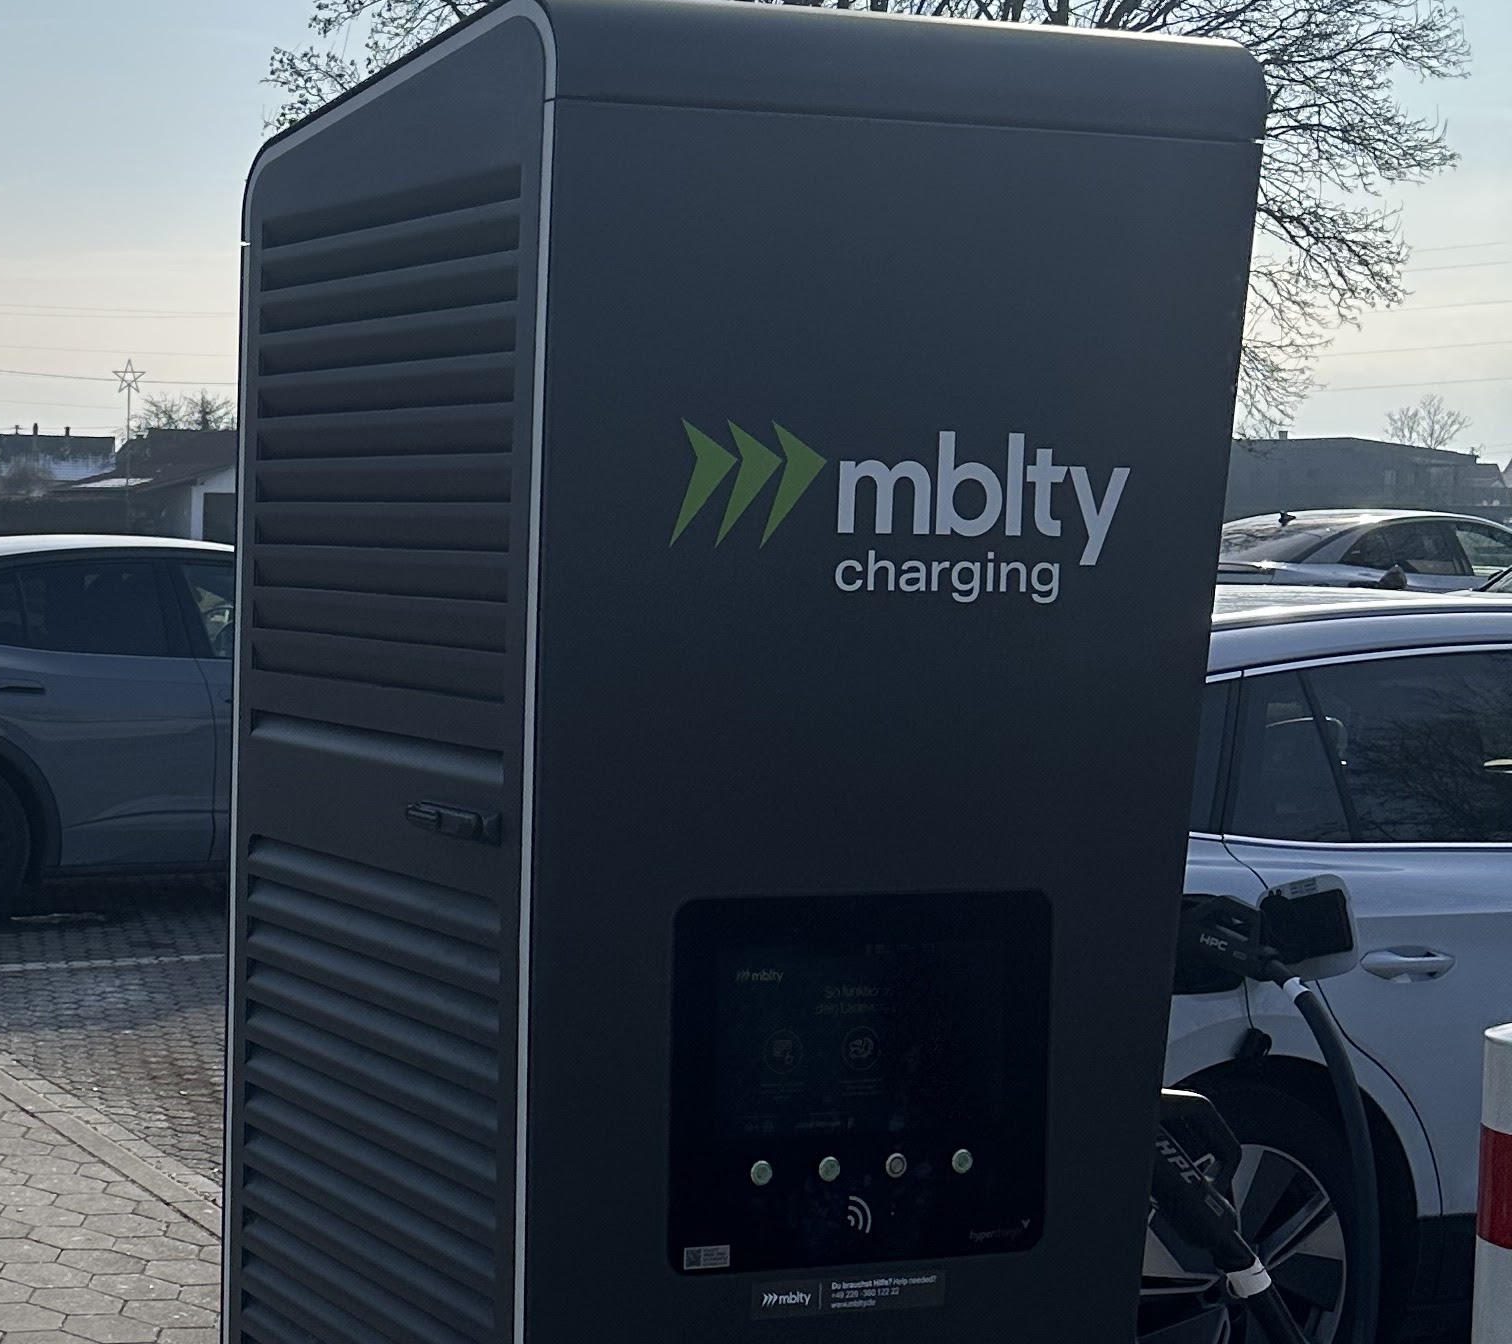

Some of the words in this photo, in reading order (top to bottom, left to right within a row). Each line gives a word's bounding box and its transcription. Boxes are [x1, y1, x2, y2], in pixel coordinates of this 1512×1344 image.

[837, 431, 1131, 566] mblty
[834, 549, 1061, 604] charging
[1199, 932, 1229, 952] HPC
[1155, 1139, 1202, 1184] HPC
[779, 1291, 812, 1306] mblty
